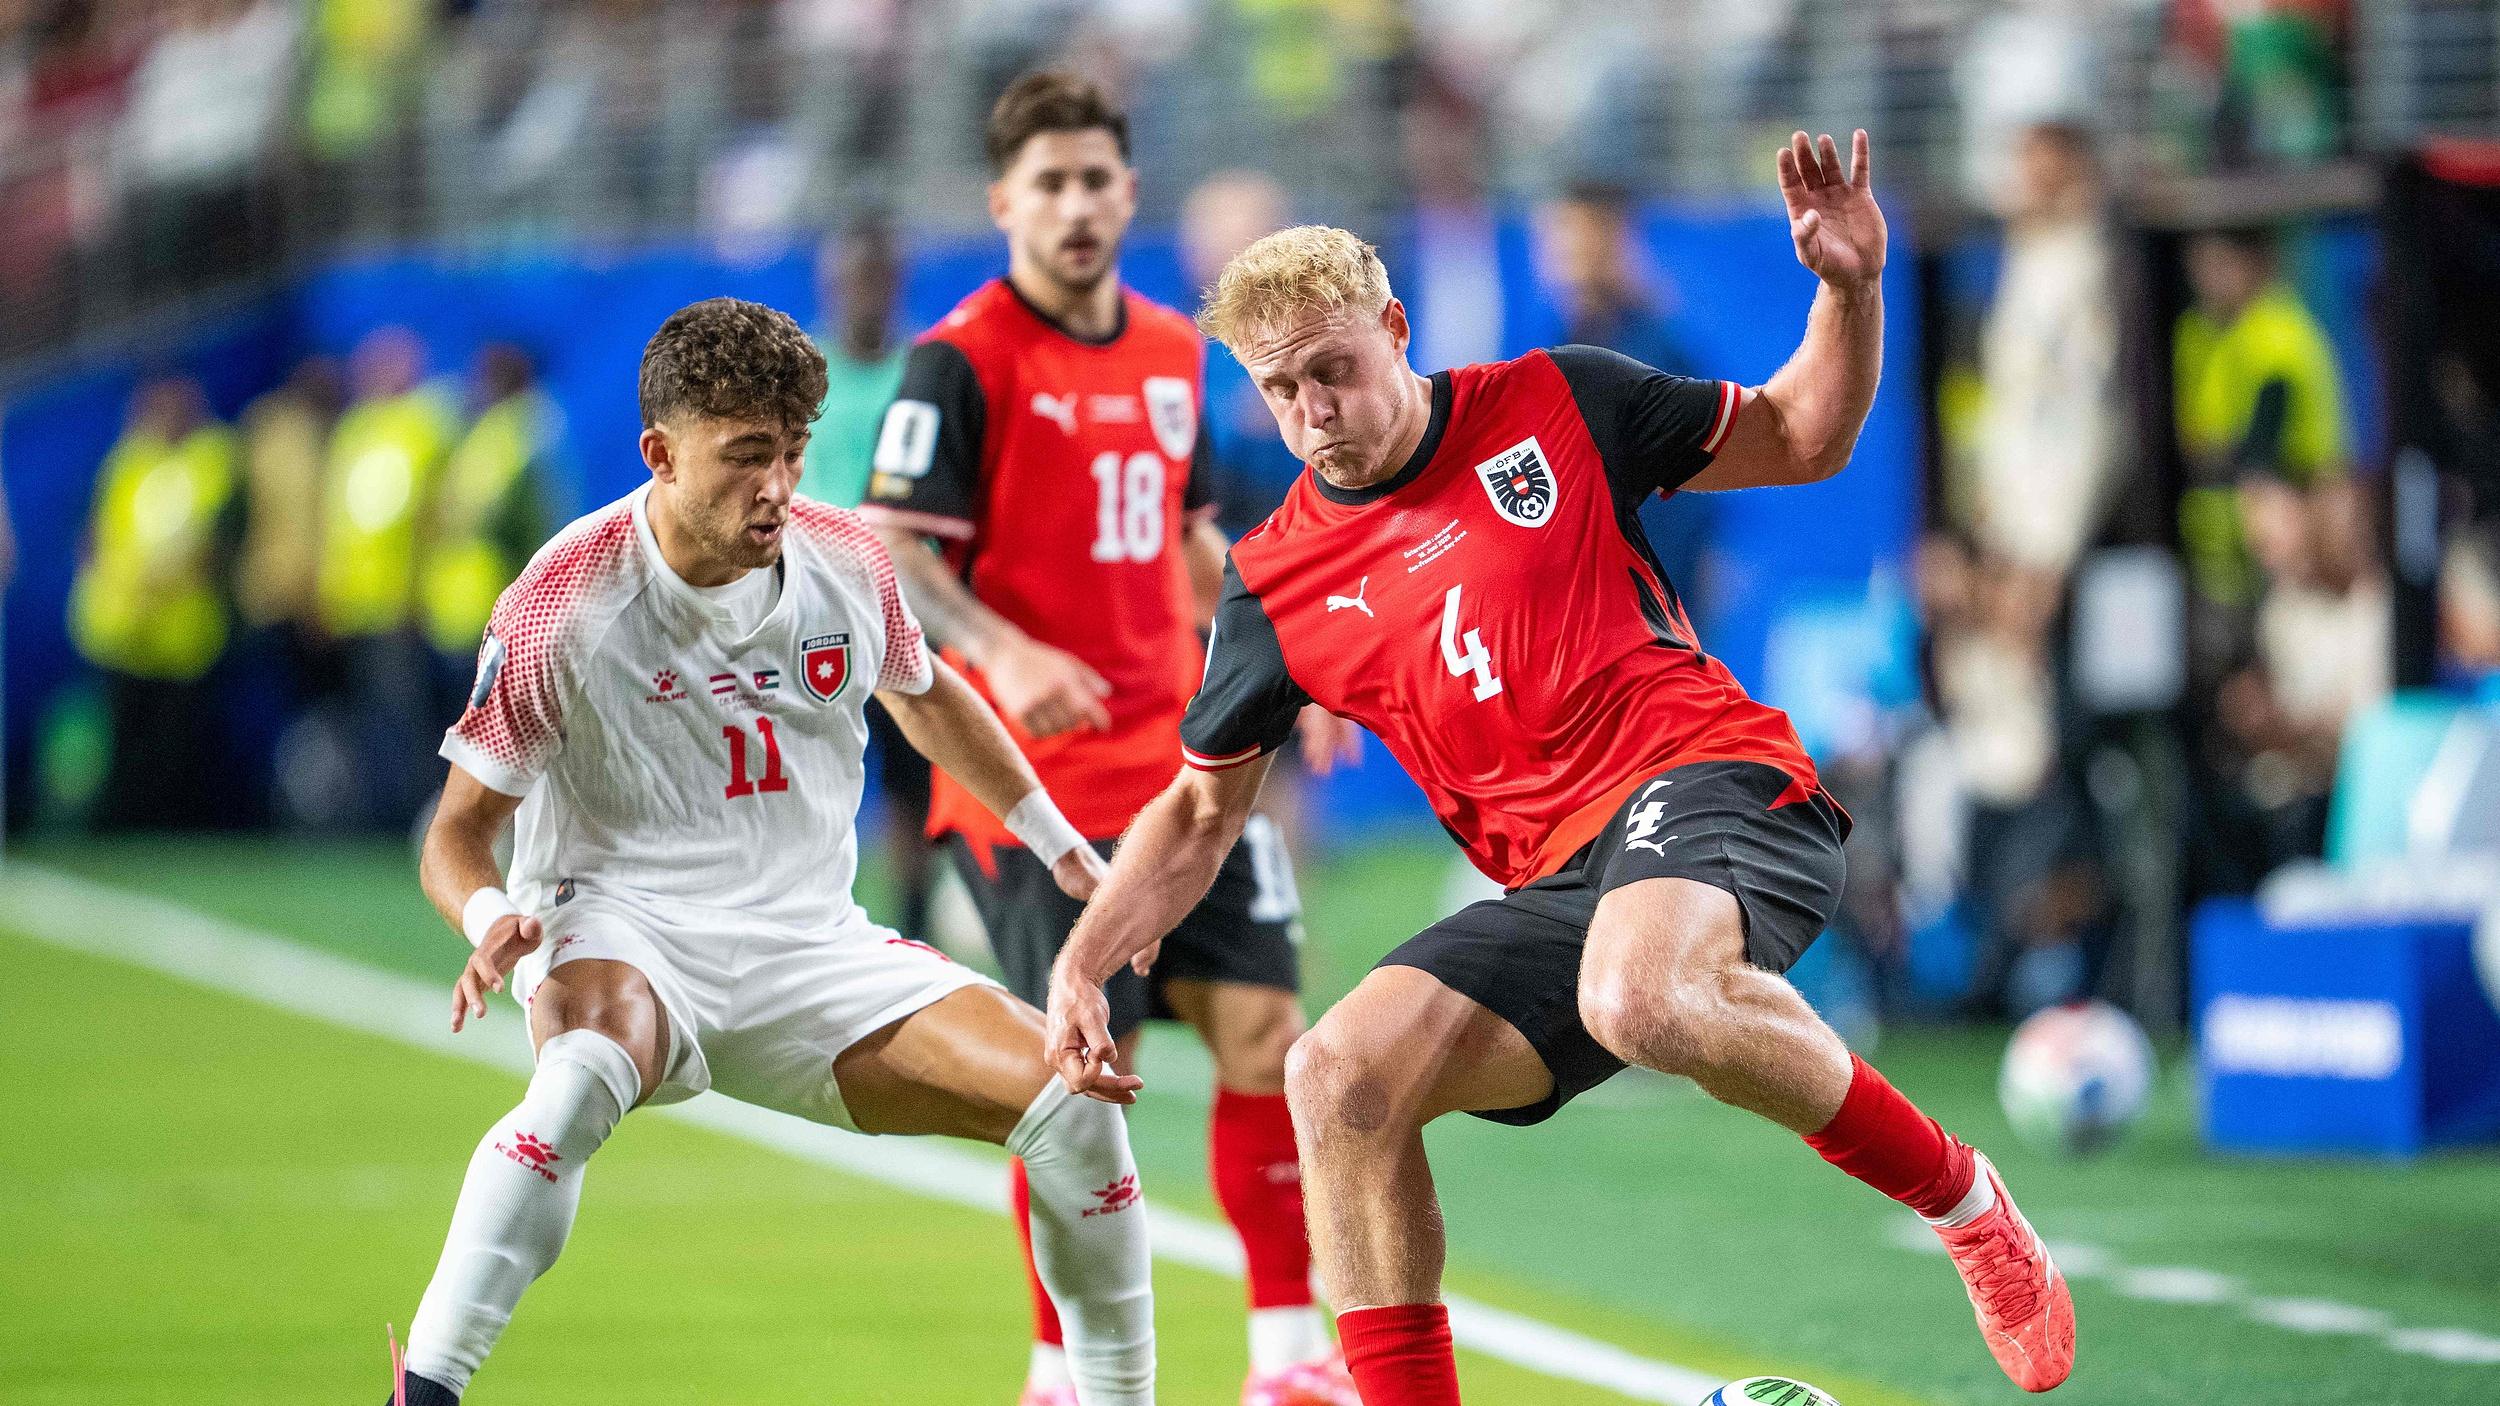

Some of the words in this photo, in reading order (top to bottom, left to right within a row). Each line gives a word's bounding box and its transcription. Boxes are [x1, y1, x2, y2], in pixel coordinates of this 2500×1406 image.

[1495, 450, 1521, 469] ÖFB
[1090, 451, 1165, 565] 18
[806, 635, 844, 649] JORDAN
[1440, 583, 1503, 703] 4
[722, 716, 788, 799] 11
[1625, 780, 1674, 844] 4
[495, 1142, 559, 1184] KELME
